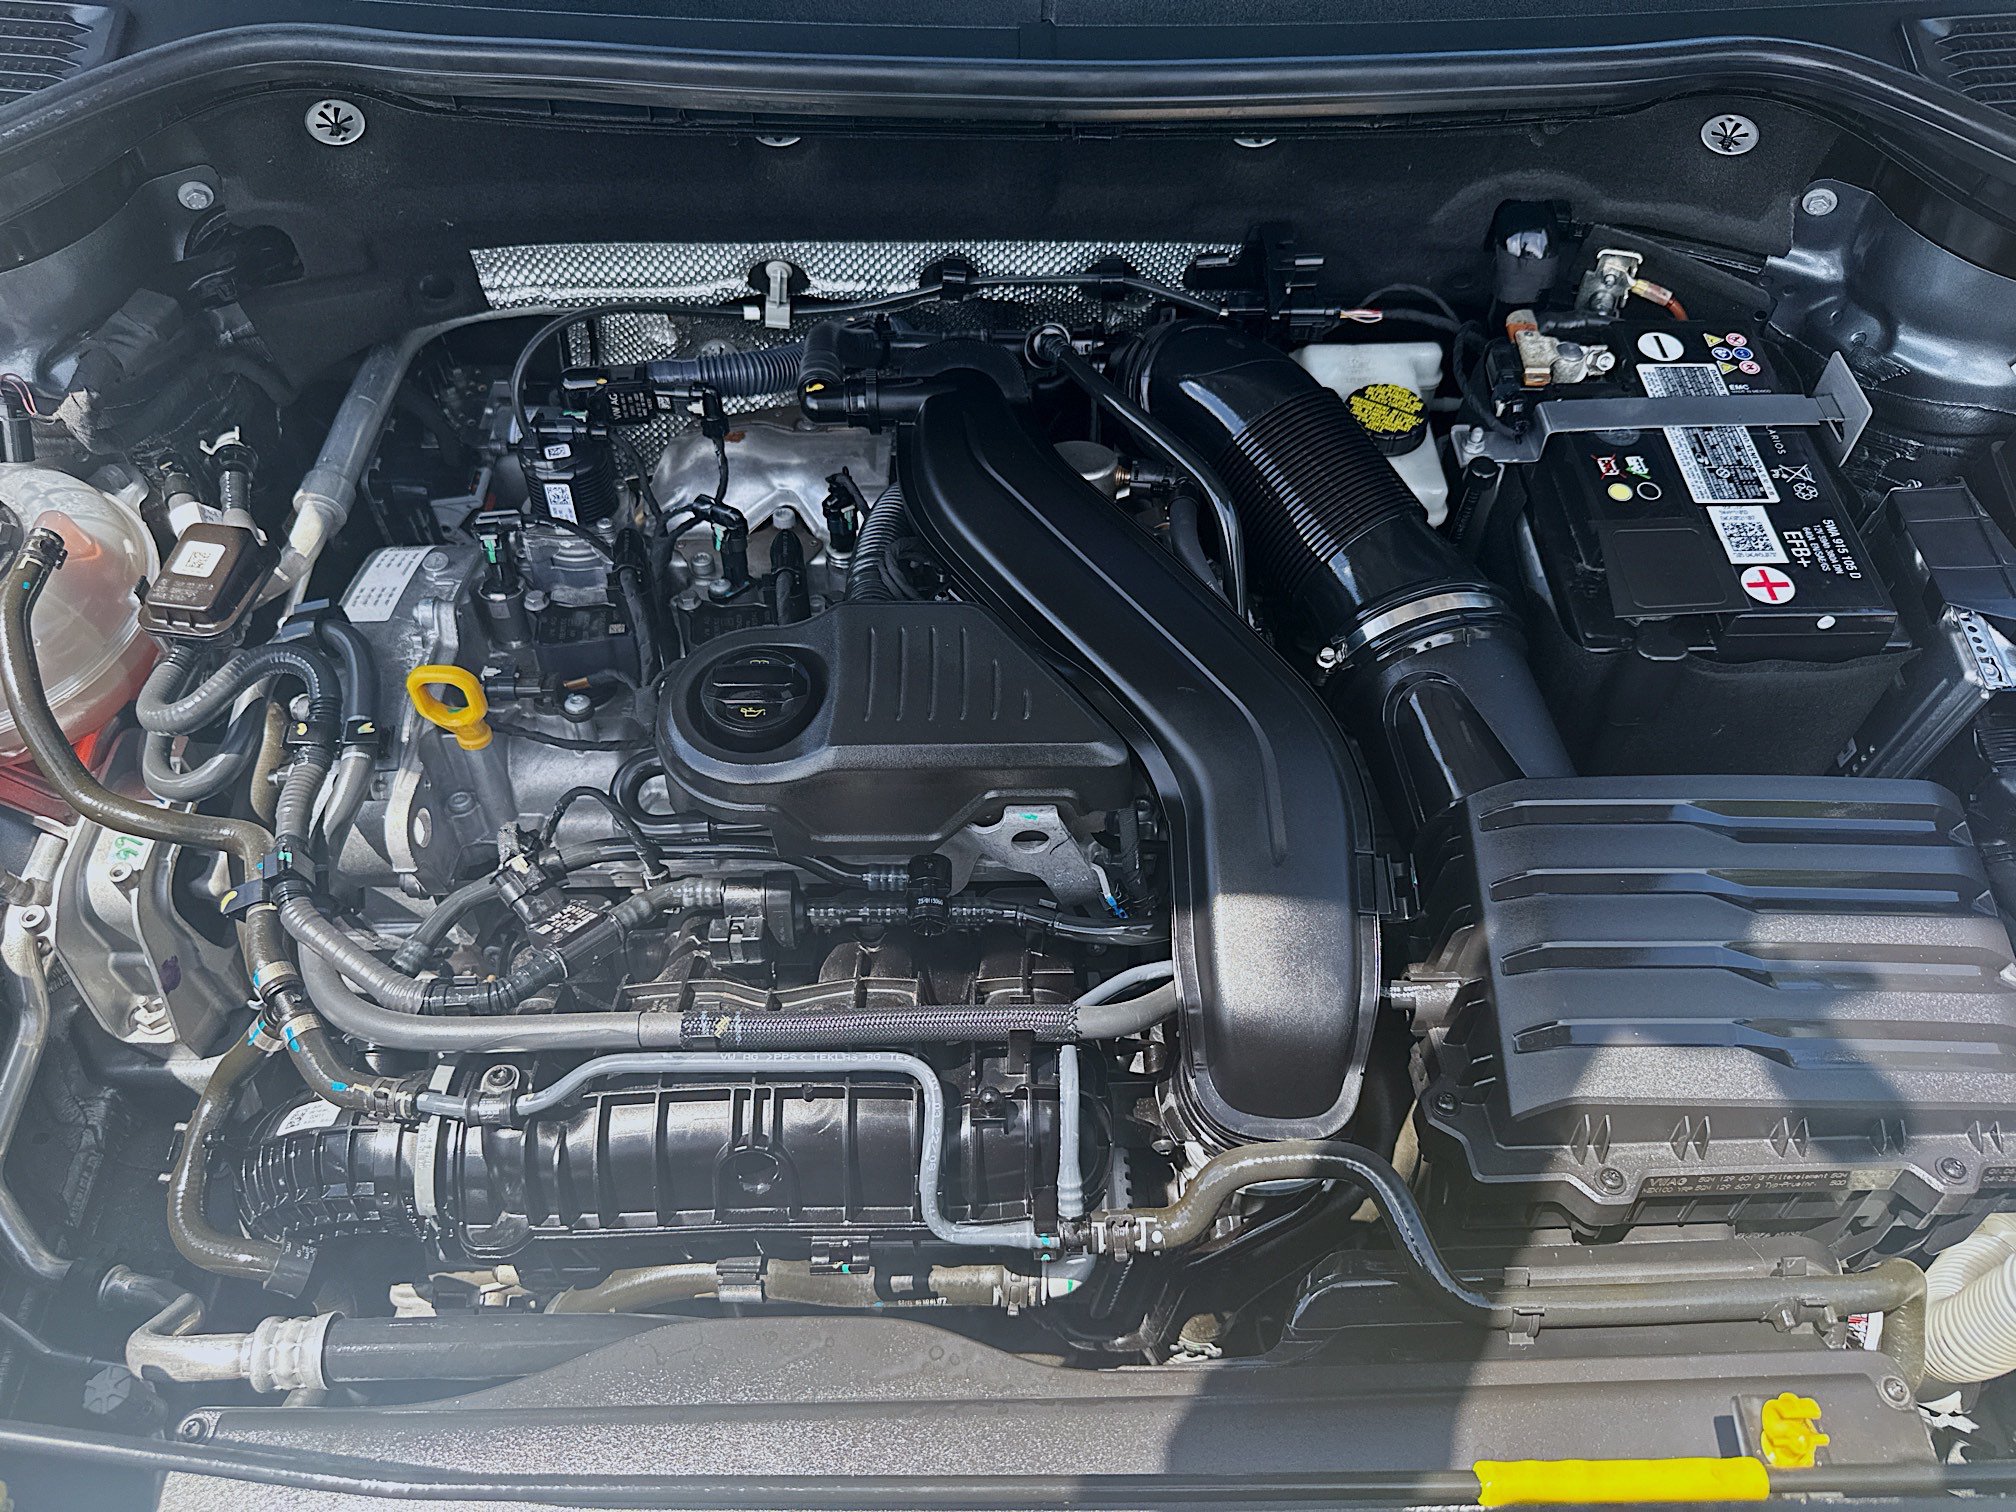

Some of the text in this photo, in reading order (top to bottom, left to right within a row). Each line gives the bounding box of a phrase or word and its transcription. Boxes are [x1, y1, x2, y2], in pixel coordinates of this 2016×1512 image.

[1782, 531, 1812, 568] EFB+
[1832, 538, 1849, 554] 915
[1841, 555, 1858, 571] 105
[720, 1053, 736, 1062] VW
[742, 1053, 759, 1062] AG
[766, 1053, 806, 1061] >PPS<
[812, 1053, 858, 1061] TEKLAS
